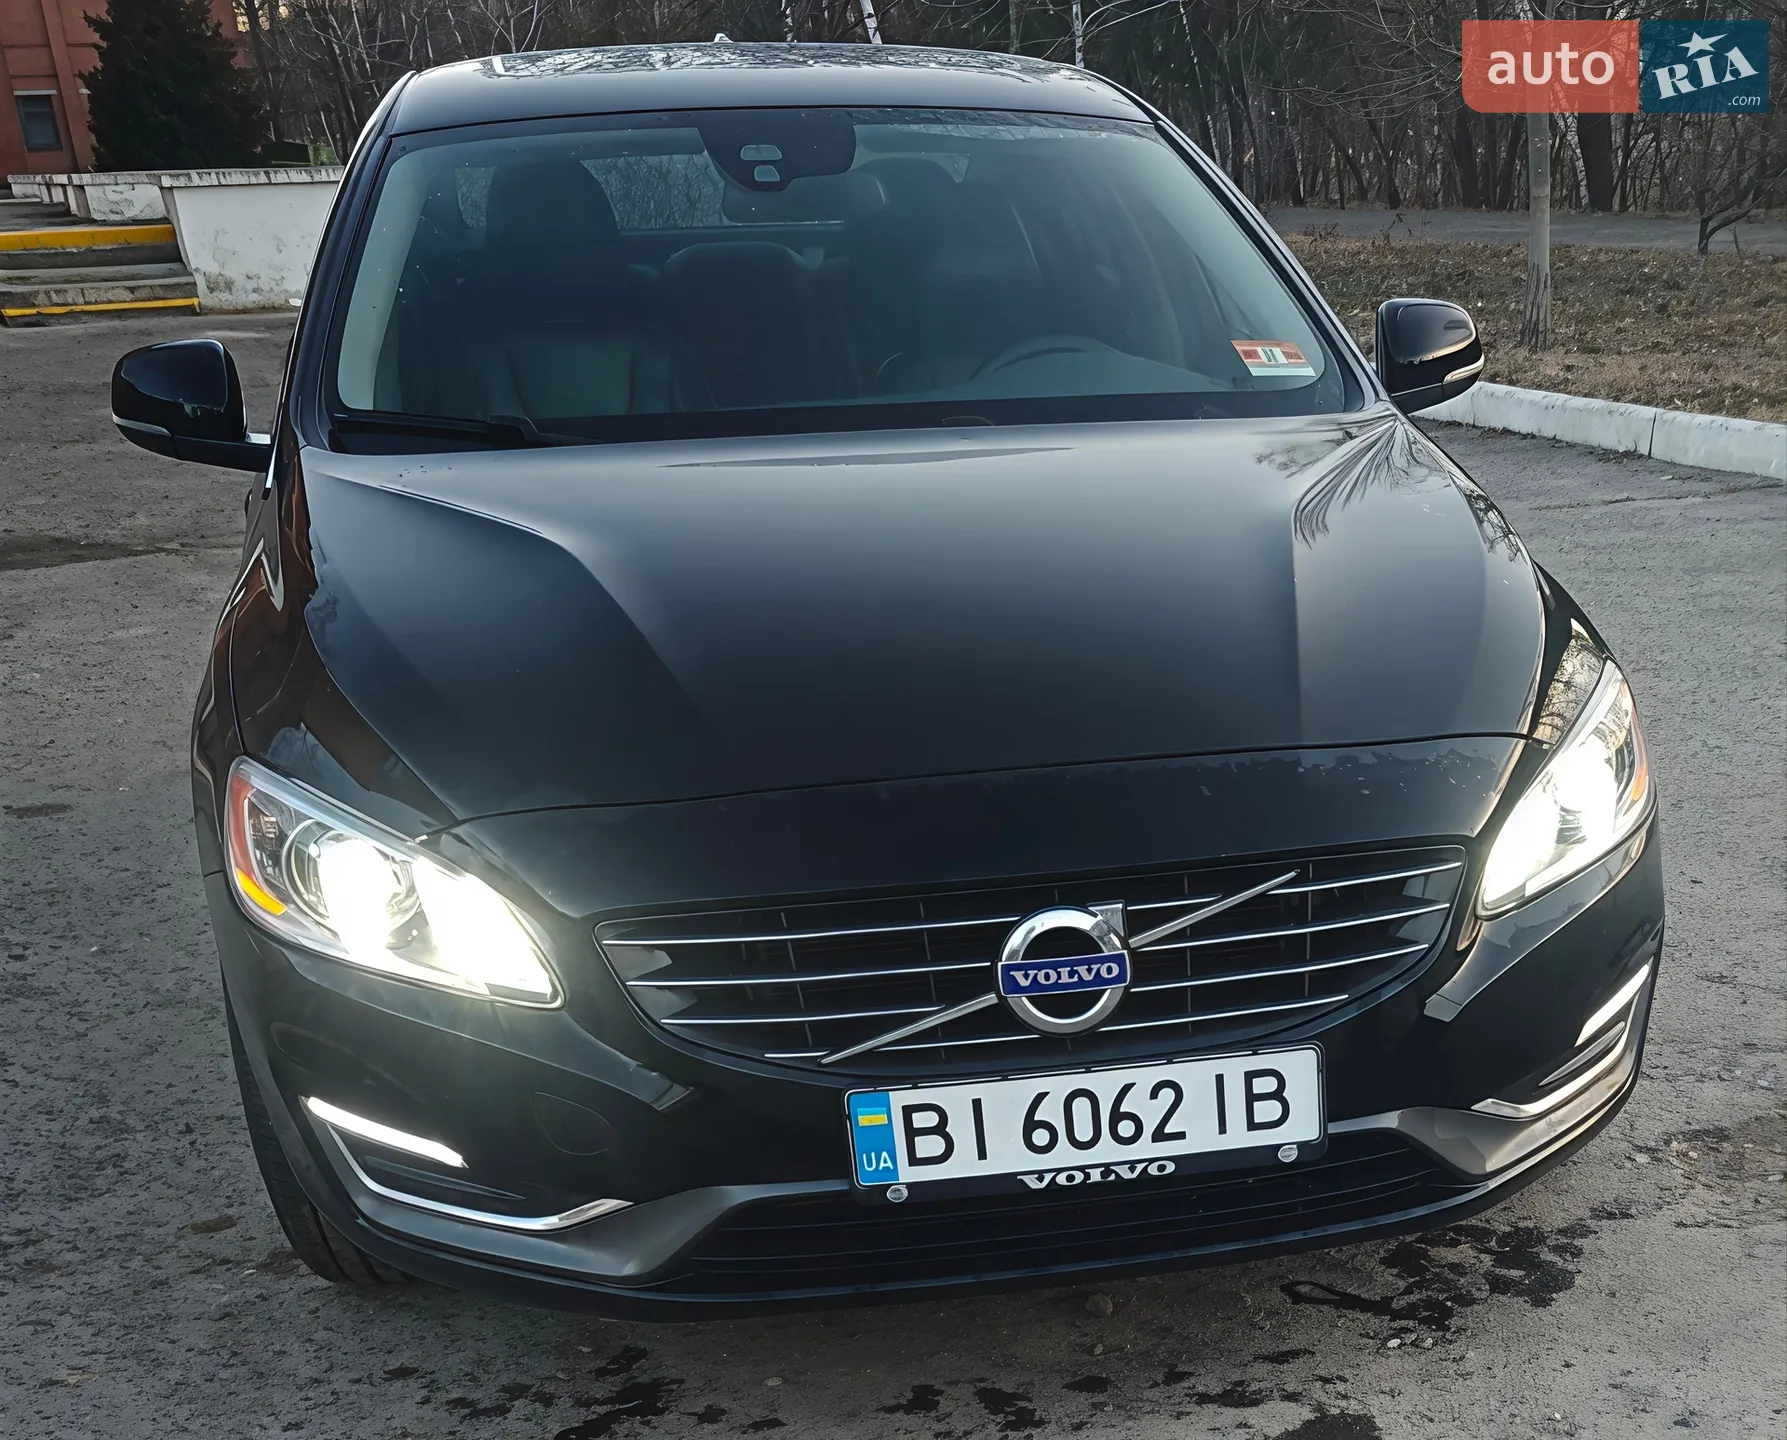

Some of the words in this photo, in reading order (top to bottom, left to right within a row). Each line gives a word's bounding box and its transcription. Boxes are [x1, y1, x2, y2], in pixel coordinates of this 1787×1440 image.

[1010, 962, 1120, 987] VOLVO
[901, 1097, 988, 1167] BI
[1022, 1079, 1187, 1155] 6062
[1214, 1068, 1291, 1136] IB
[862, 1151, 894, 1172] UA
[1017, 1160, 1176, 1190] VOLVO
